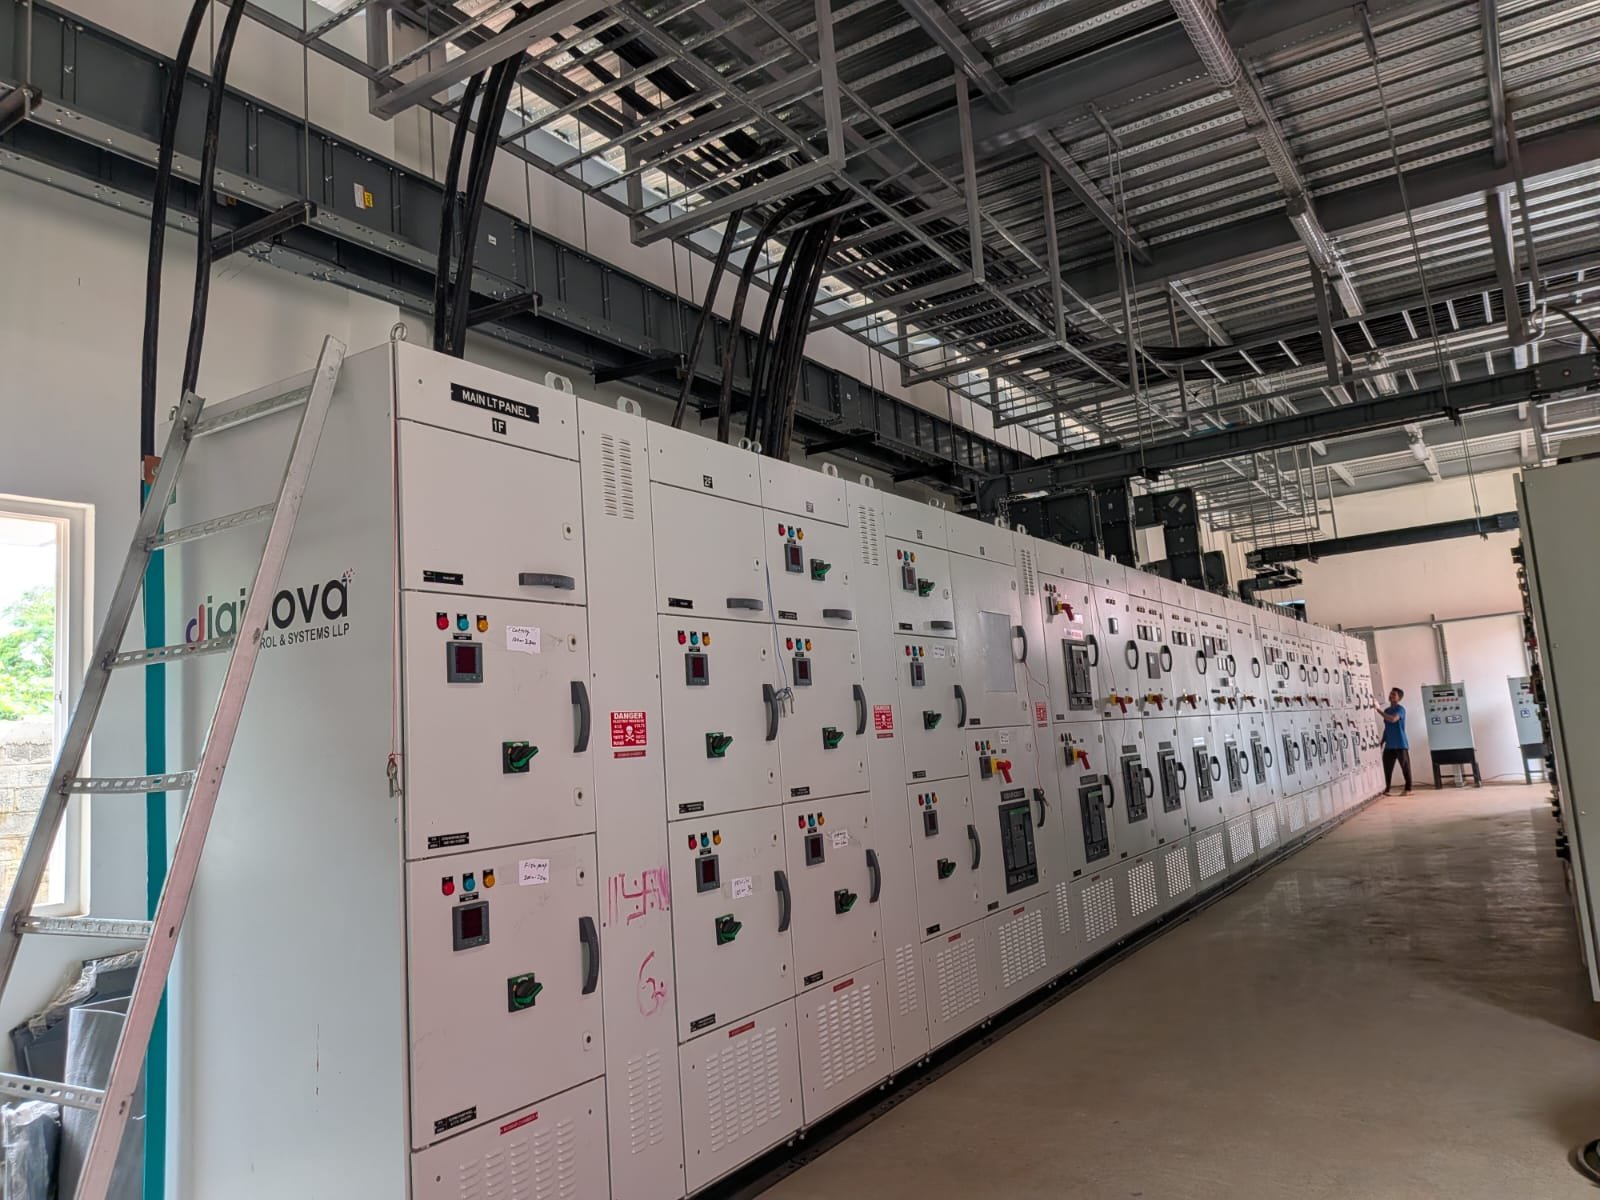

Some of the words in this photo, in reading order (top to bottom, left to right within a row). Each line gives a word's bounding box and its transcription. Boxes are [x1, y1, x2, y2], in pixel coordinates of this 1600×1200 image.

[462, 390, 486, 405] MAIN
[487, 396, 497, 409] LT
[498, 400, 531, 418] PANEL
[493, 419, 505, 433] 1F
[279, 634, 286, 646] &
[287, 626, 330, 645] SYSTEMS
[332, 622, 350, 638] LLP
